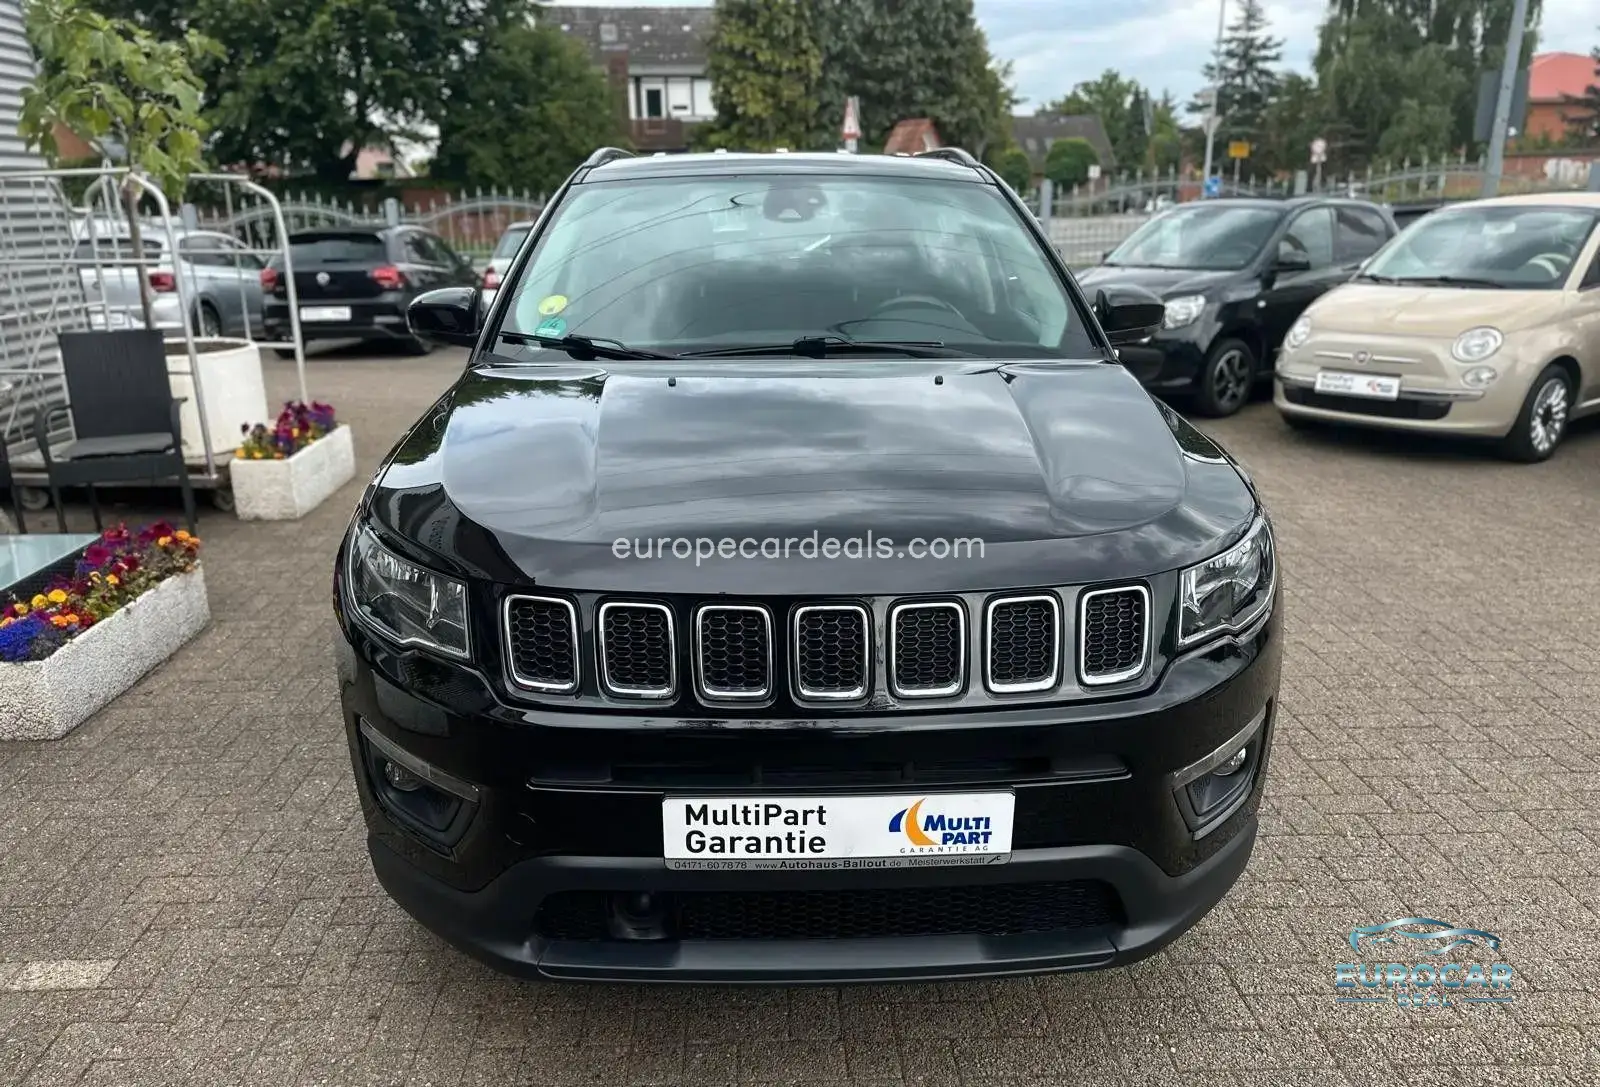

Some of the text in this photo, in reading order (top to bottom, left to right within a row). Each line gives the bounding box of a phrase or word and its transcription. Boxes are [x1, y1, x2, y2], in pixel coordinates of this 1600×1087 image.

[685, 803, 827, 826] MultiPart
[923, 815, 991, 832] MULTI
[685, 830, 827, 854] Garantie
[941, 831, 993, 845] PART
[899, 846, 967, 854] GARANTIE
[908, 857, 985, 867] Meisterwerkstatt
